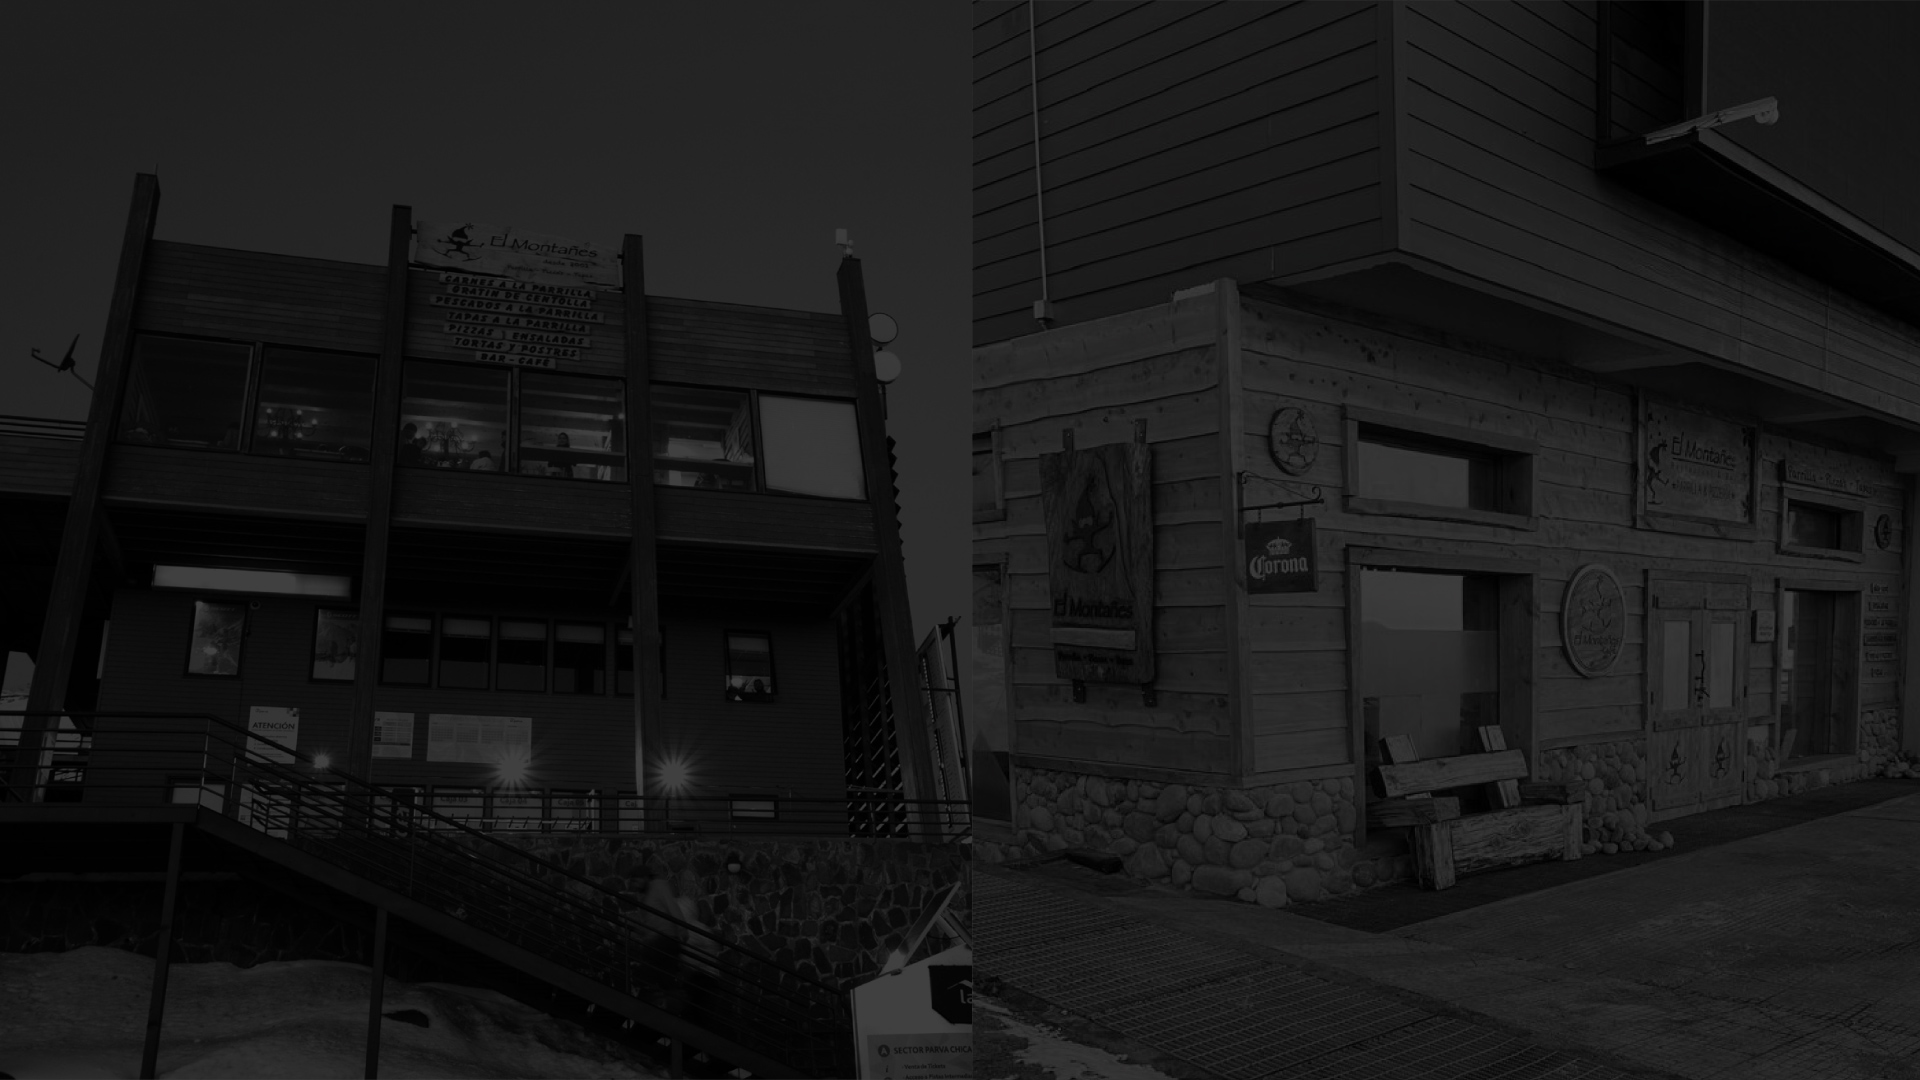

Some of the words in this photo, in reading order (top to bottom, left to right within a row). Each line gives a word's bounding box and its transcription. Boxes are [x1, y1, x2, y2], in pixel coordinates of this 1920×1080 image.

[490, 233, 508, 247] El
[510, 238, 598, 258] Montañes
[445, 275, 495, 287] CARNES
[512, 282, 526, 290] LA
[532, 284, 591, 298] PARRILLA
[452, 285, 500, 298] GRATIN
[505, 291, 520, 300] DE
[526, 293, 588, 308] CENTOLLA
[435, 296, 501, 310] PESCADOS
[519, 305, 533, 313] LA
[538, 307, 599, 321] PARRILLA
[448, 311, 488, 323] TAPAS
[493, 316, 500, 324] A
[506, 317, 520, 326] LA
[526, 319, 587, 333] PARRILLA
[449, 324, 494, 336] PIZZAS
[512, 332, 585, 345] ENSALADAS
[454, 337, 503, 349] TORTAS
[509, 343, 516, 351] Y
[521, 345, 577, 358] POSTRES
[1671, 431, 1684, 455] El
[1684, 440, 1736, 468] Montañes
[1249, 554, 1308, 581] Corona
[1053, 589, 1068, 617] El
[1069, 597, 1133, 619] Montañes
[252, 721, 295, 730] ATENCIÓN
[893, 1046, 924, 1054] SECTOR
[925, 1046, 950, 1054] PARVA
[950, 1045, 972, 1053] CHICA
